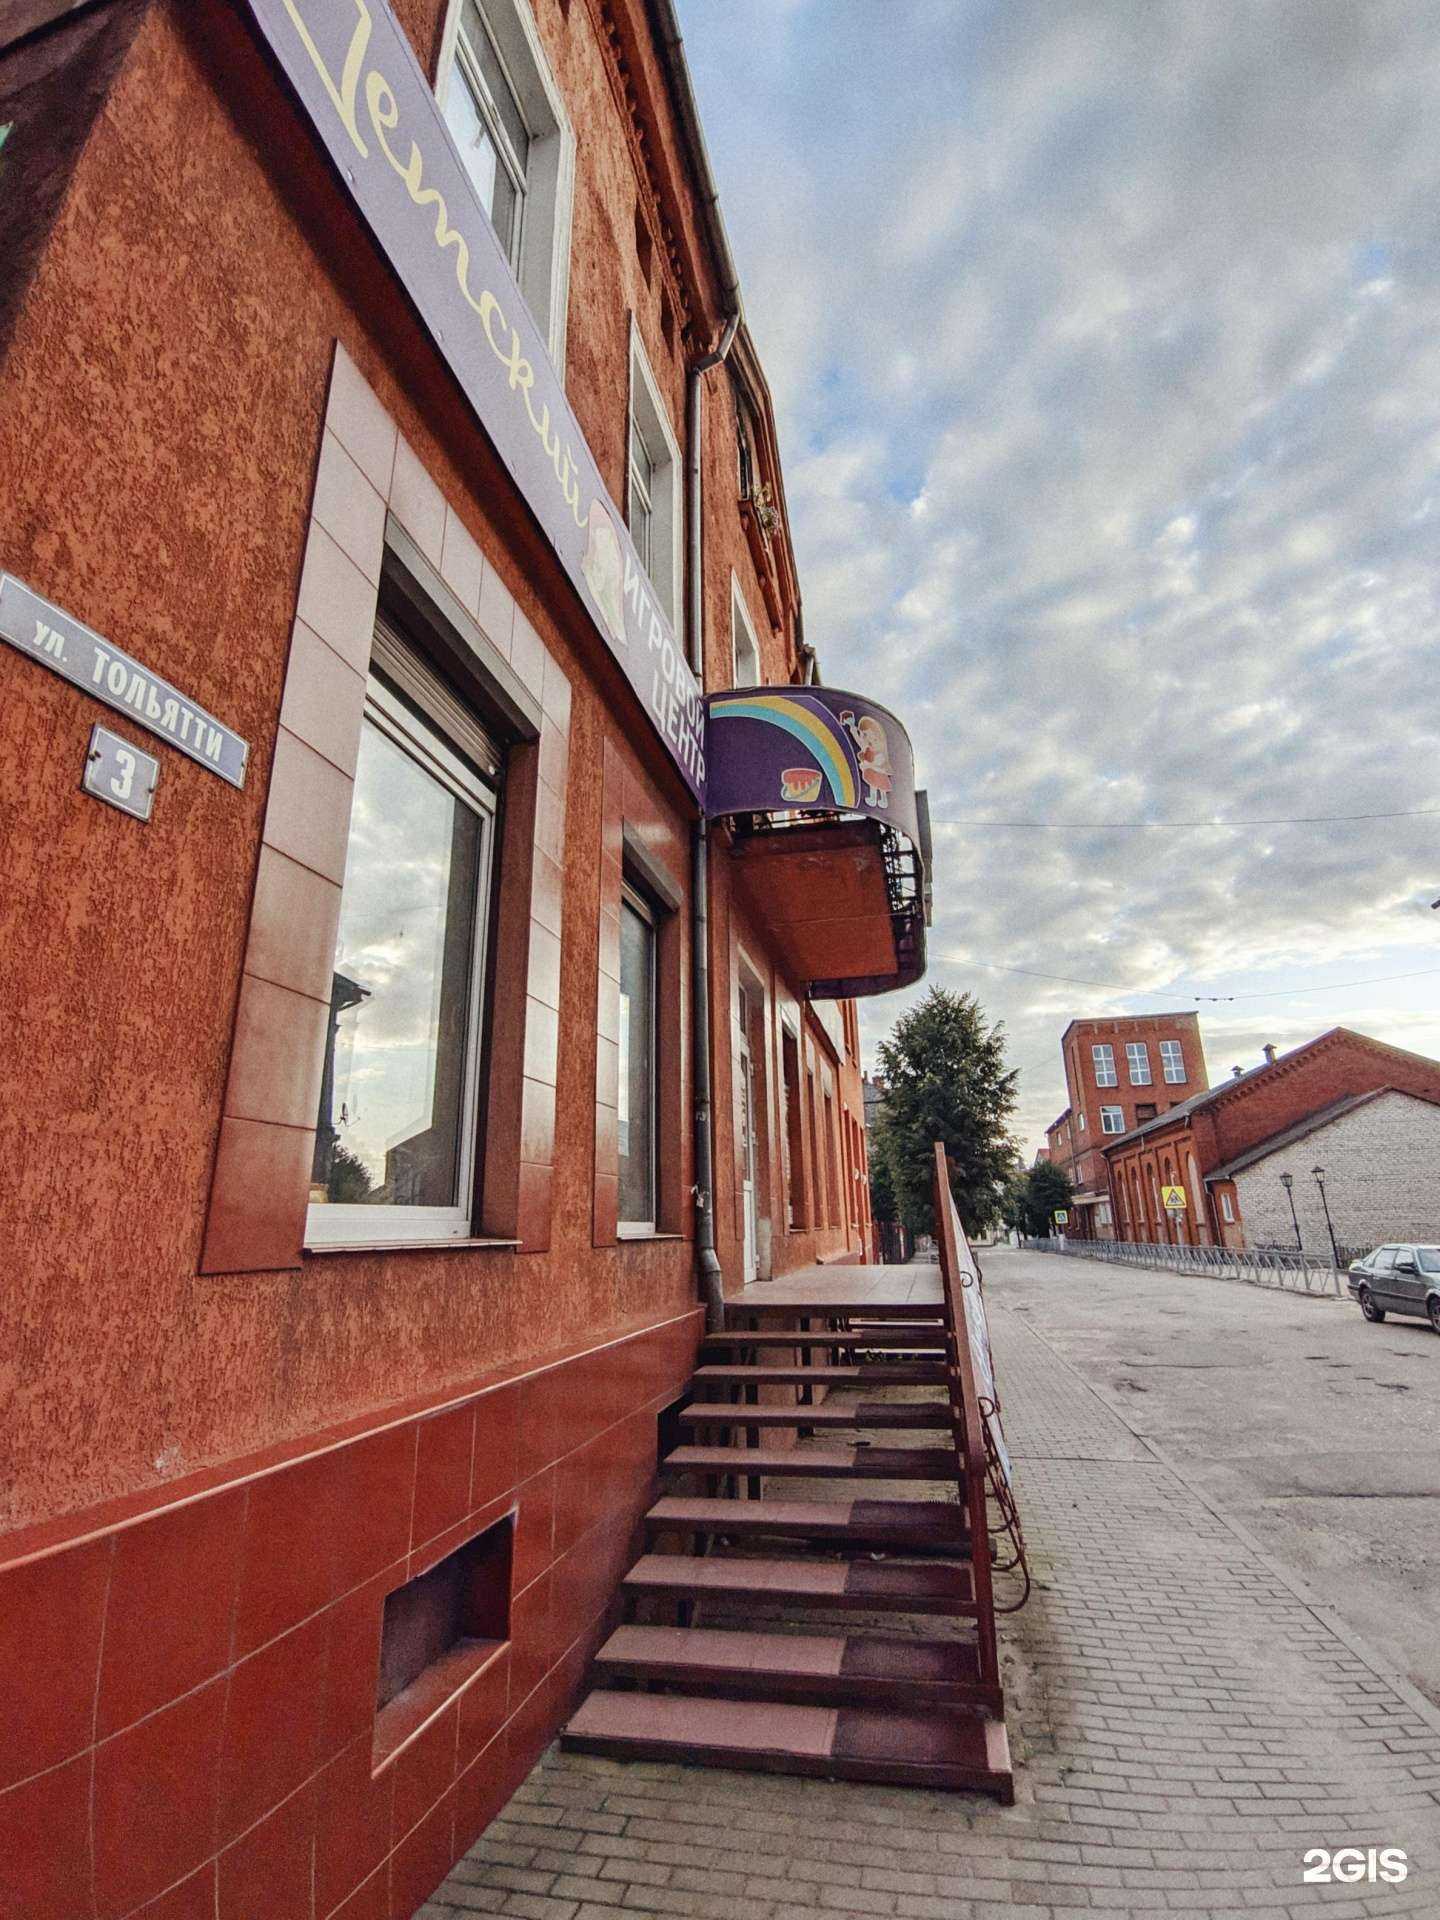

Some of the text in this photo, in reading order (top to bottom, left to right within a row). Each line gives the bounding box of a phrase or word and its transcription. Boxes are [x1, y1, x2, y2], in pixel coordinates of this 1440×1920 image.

[93, 646, 222, 762] ТОЛЬЯТТИ
[624, 555, 704, 751] ИГРОВОЙ
[110, 749, 136, 799] 3
[652, 669, 705, 788] ЦЕНТР
